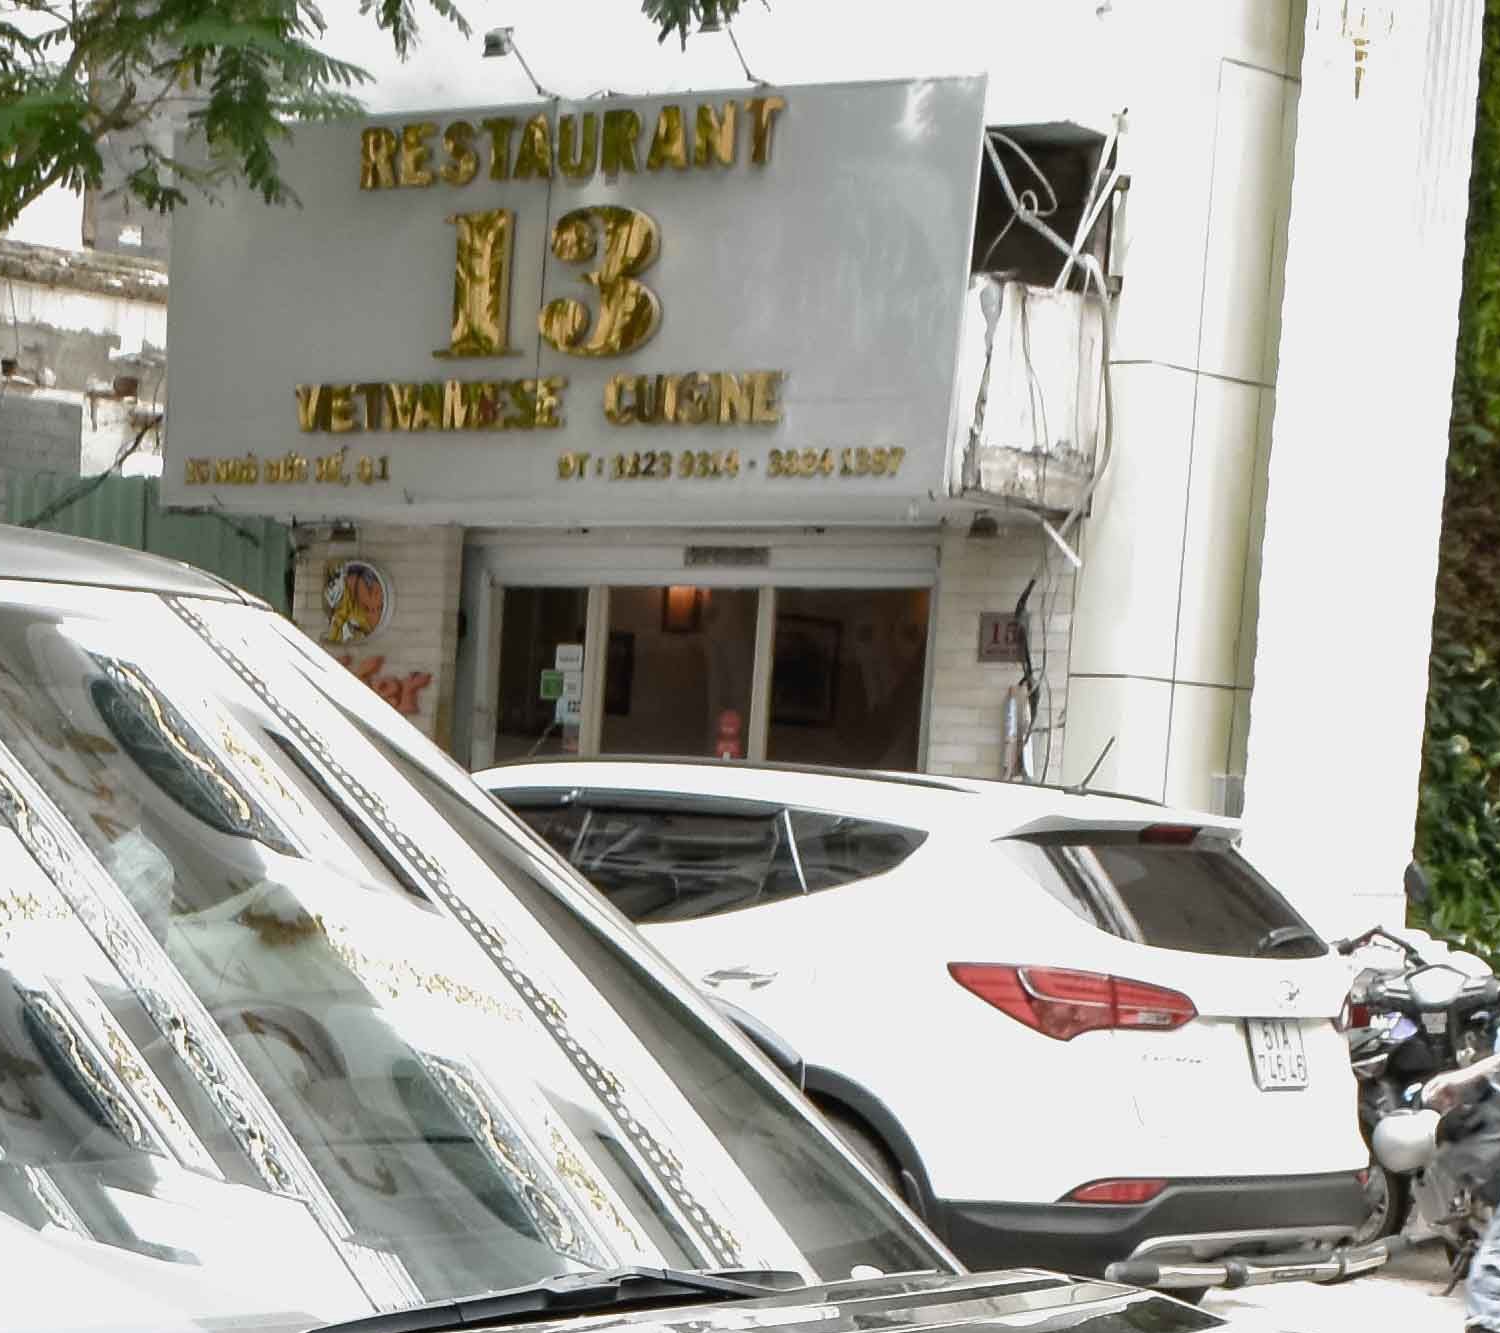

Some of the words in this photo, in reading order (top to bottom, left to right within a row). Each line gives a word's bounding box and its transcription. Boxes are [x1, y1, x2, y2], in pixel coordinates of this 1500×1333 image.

[361, 98, 787, 190] RESTAURANT
[431, 205, 662, 360] 13
[604, 370, 785, 425] CUISINE
